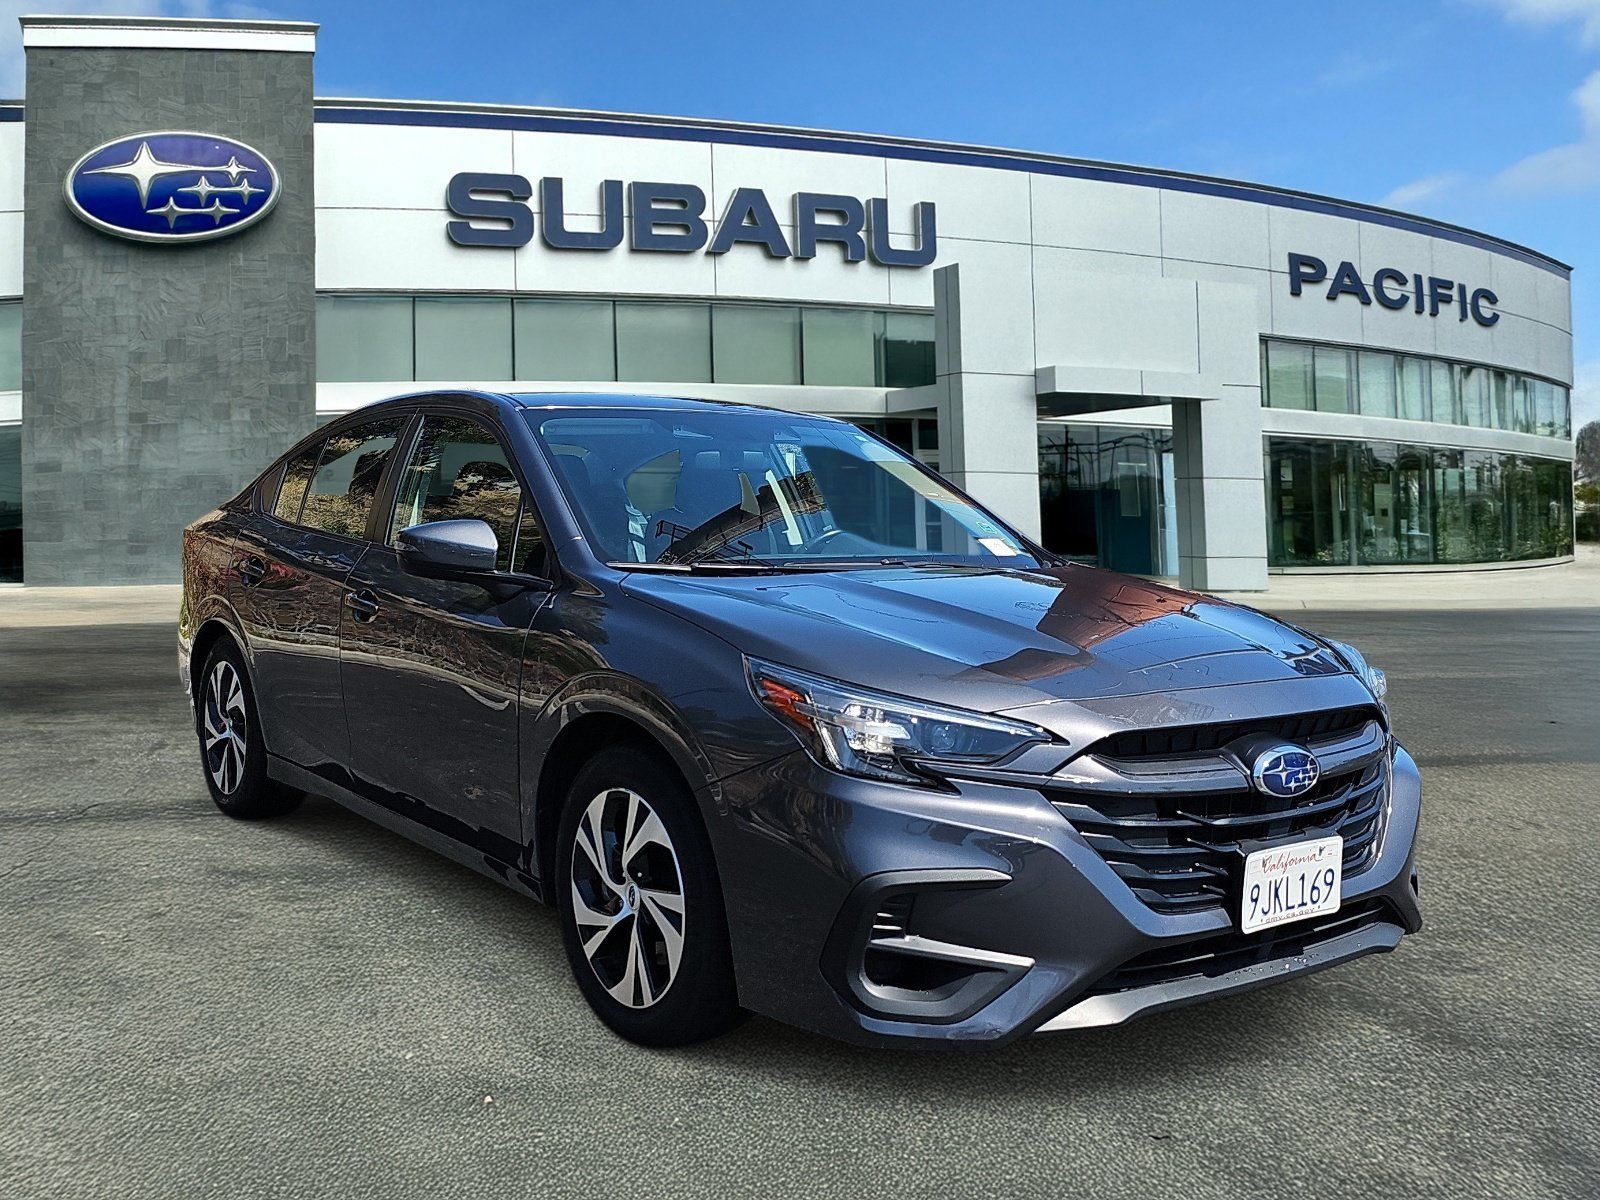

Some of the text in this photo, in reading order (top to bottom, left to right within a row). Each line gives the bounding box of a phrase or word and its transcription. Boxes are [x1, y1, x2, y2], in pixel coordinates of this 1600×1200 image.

[446, 172, 937, 266] SUBARU
[1288, 252, 1500, 327] PACIFIC
[1263, 849, 1323, 874] California
[1249, 868, 1335, 922] 9JKL169
[1265, 908, 1315, 924] dmv.ca.gov
